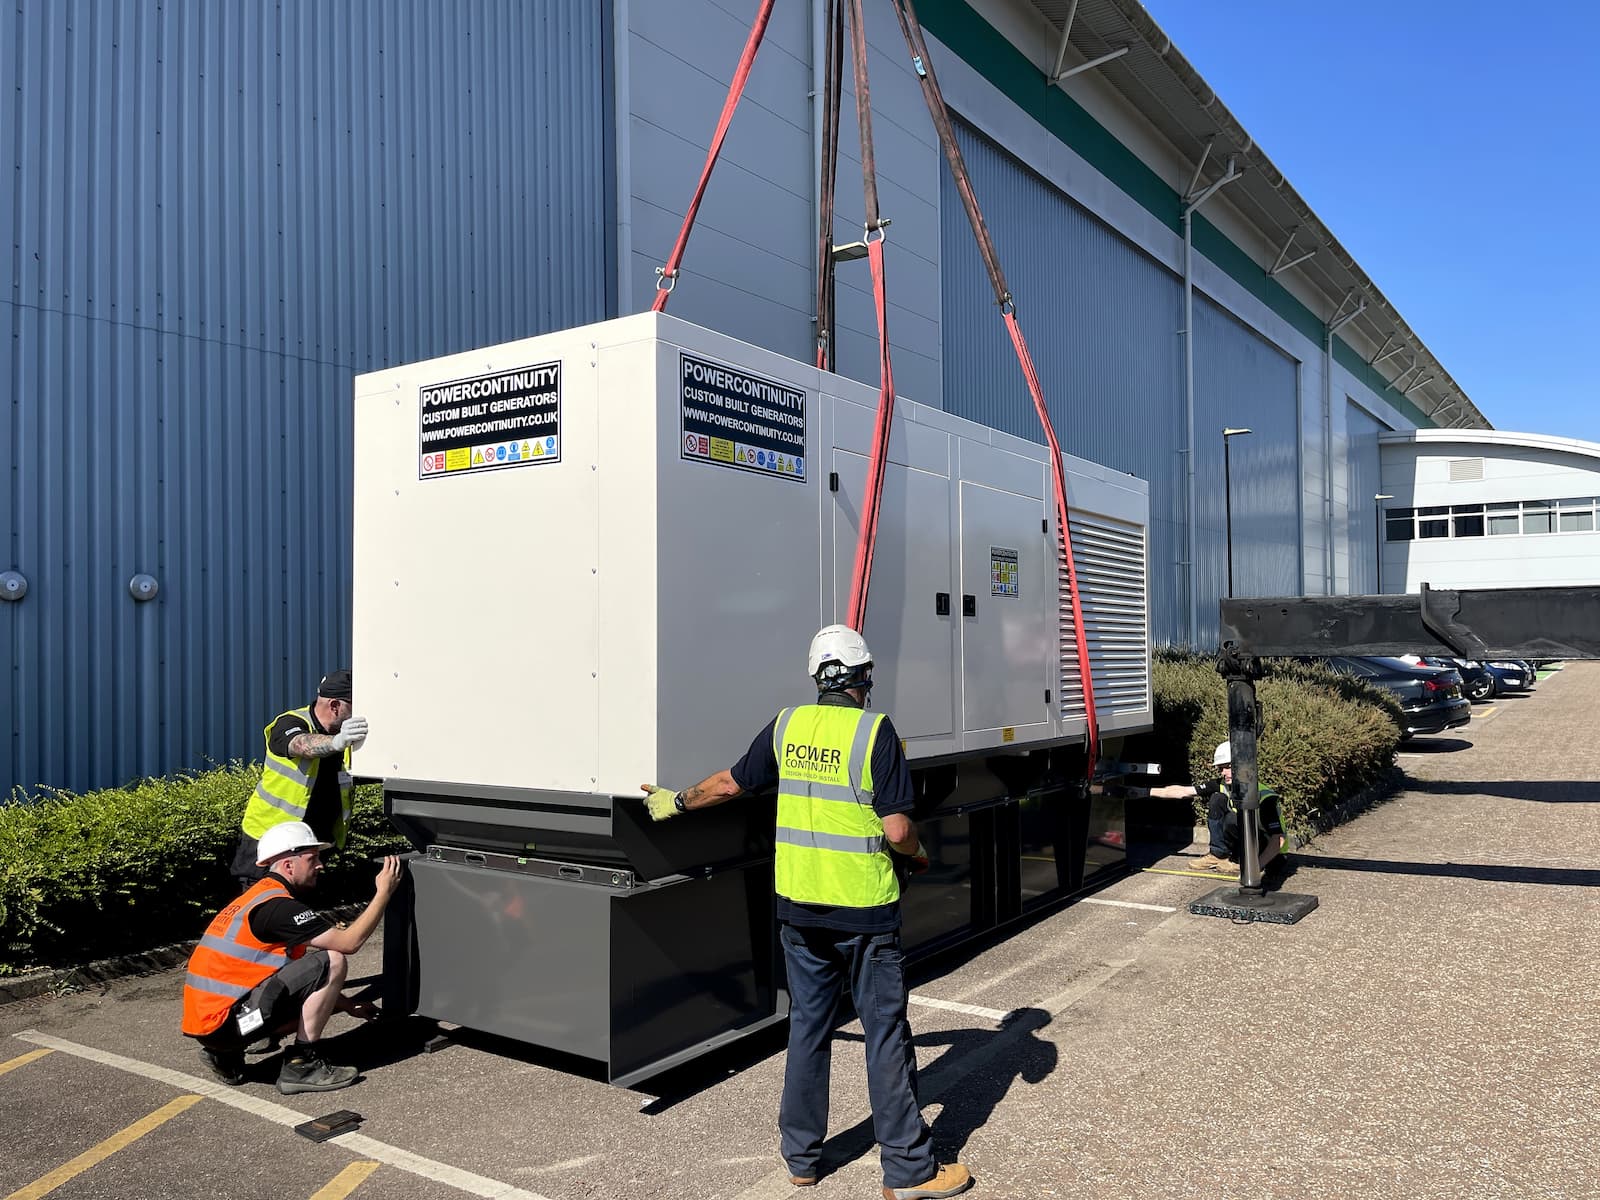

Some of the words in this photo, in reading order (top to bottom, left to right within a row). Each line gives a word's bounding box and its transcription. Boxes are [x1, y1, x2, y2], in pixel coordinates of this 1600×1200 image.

[422, 367, 558, 407] POWERCONTINUITY
[684, 361, 803, 410] POWERCONTINUITY
[422, 408, 460, 424] CUSTOM
[461, 403, 489, 418] BUILT
[489, 391, 557, 413] GENERATORS
[422, 411, 558, 442] WWW.POWERCONTINUITY.CO.UK
[683, 406, 804, 446] WWW.POWERCONTINUITY.CO.UK
[684, 386, 724, 407] CUSTOM
[724, 397, 750, 413] BUILT
[750, 404, 804, 428] GENERATORS
[786, 743, 841, 765] POWER
